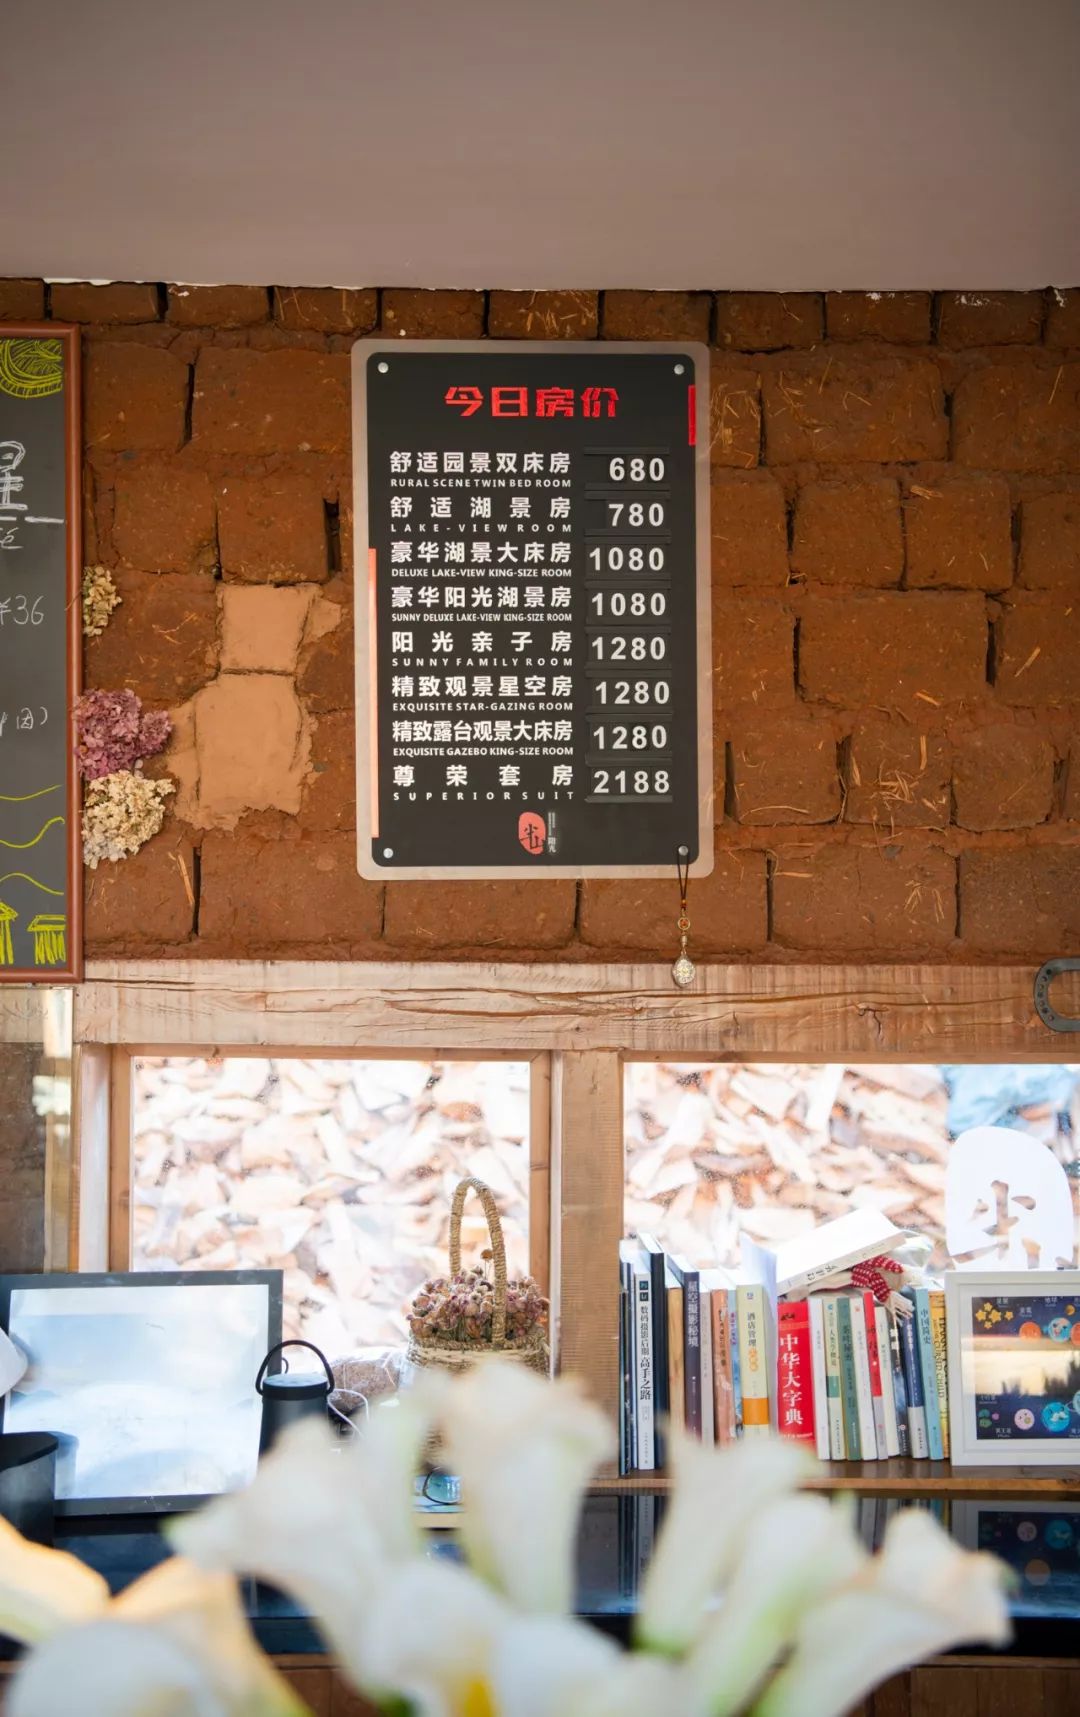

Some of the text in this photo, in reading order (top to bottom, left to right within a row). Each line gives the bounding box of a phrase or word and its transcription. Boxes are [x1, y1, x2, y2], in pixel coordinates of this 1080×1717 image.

[444, 386, 620, 418] 今日房价
[390, 451, 665, 482] 舒适园景双床房 680
[391, 479, 571, 488] RURAL SCENE TWIN BED ROOM
[390, 496, 664, 527] 舒适湖景房 780
[391, 541, 664, 571] 豪华湖景大床房 1080
[392, 568, 572, 577] DELUXE LAKE-VIEW KING-SIZE ROOM
[391, 586, 666, 616] 豪华阳光湖景房 1080
[392, 613, 572, 622] SUNNY DELUXE LAKE-VIEW KING-SIZE ROOM
[392, 631, 666, 661] 阳光亲子房 1280
[392, 657, 573, 666] SUNNY FAMILY ROOM
[392, 675, 670, 704] 精致观景星空房 1280
[393, 702, 573, 712] EXQUISITE STAR-GAZING ROOM
[392, 720, 667, 749] 精致露台观景大床房 1280
[393, 747, 573, 757] EXQUISITE GAZEBO KING-SIZE ROOM
[393, 764, 670, 794] 尊荣套房 2188
[394, 792, 574, 801] SUPERIOR SUIT
[780, 1334, 804, 1425] 中华大字典
